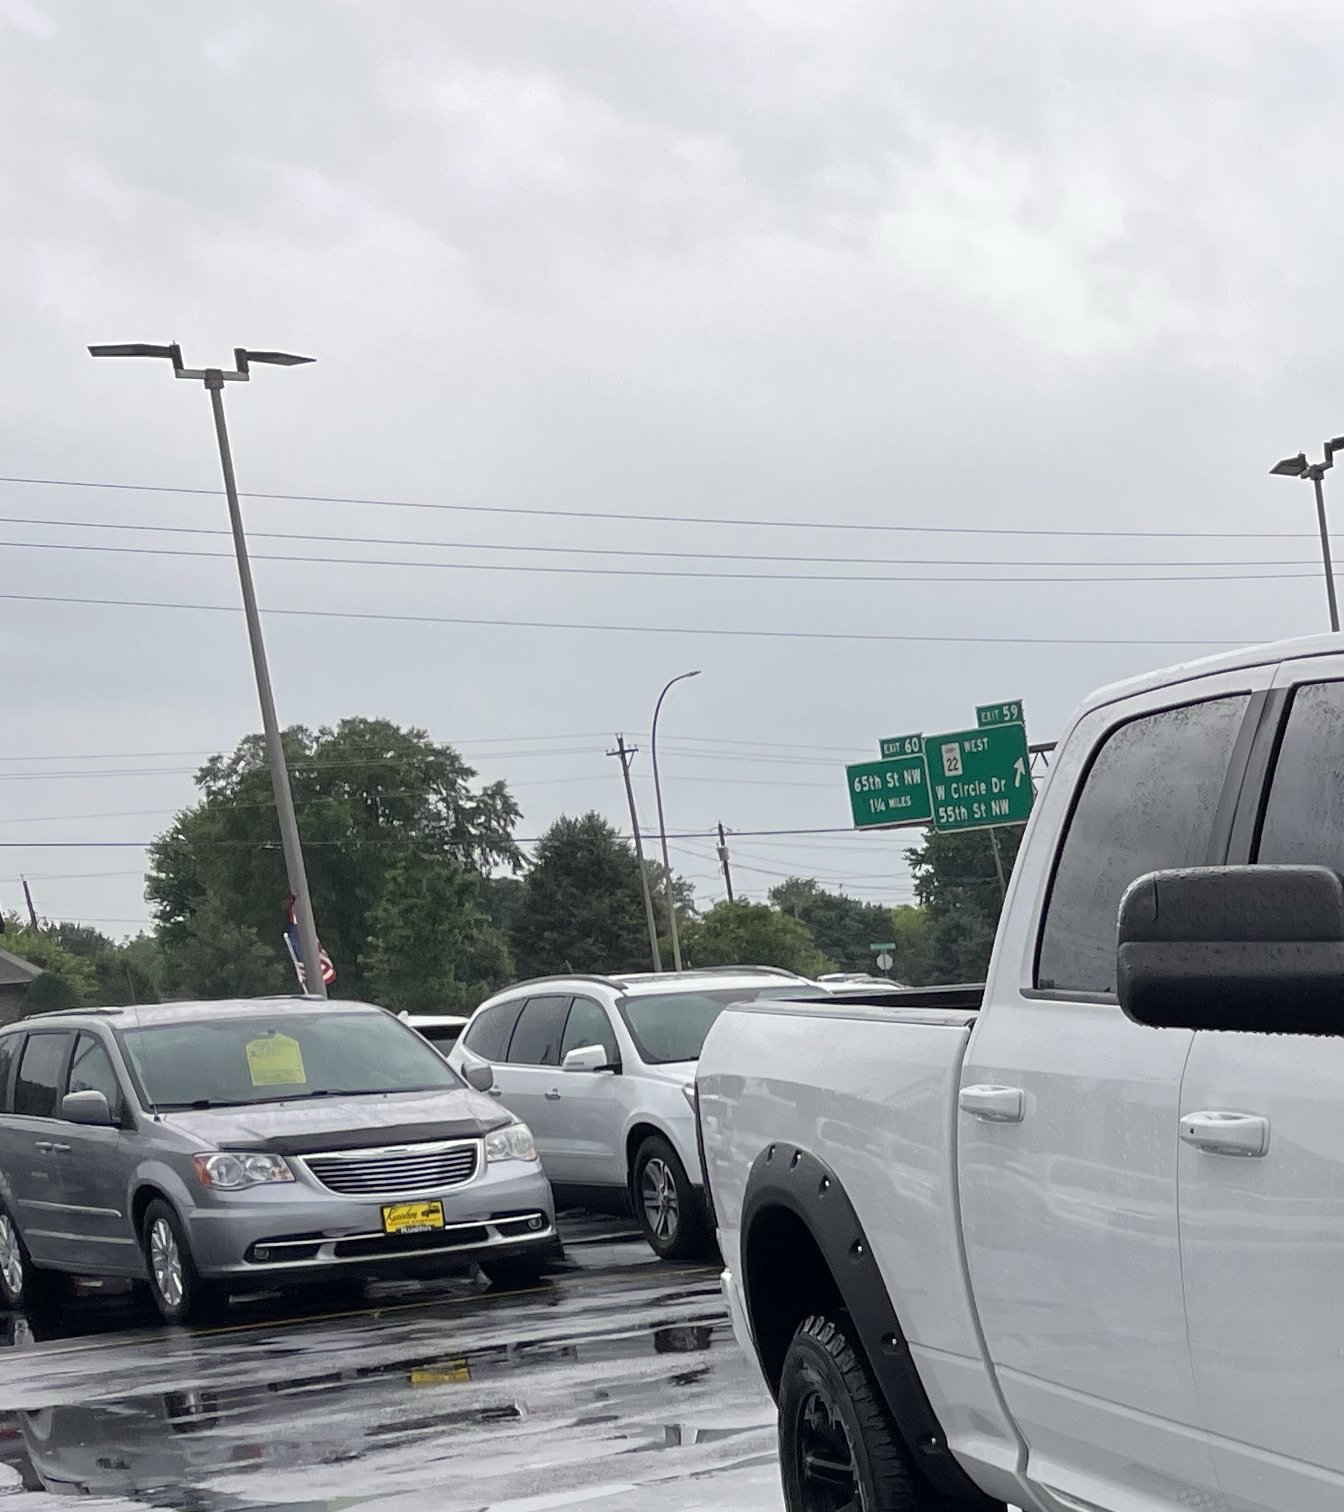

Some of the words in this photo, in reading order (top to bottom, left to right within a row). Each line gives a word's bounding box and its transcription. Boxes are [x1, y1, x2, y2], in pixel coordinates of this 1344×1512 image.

[981, 709, 999, 722] EXIT
[1003, 704, 1018, 720] 59
[884, 742, 900, 754] EXIT
[904, 737, 919, 753] 60
[963, 737, 988, 753] WEST
[946, 757, 959, 772] 22
[854, 774, 882, 793] 65th
[886, 771, 899, 788] St
[903, 768, 921, 785] NW
[936, 784, 945, 800] W
[951, 780, 986, 798] Circle
[991, 777, 1006, 793] Dr
[888, 795, 912, 808] MILES
[939, 805, 968, 823] 55th
[972, 802, 986, 818] St
[991, 799, 1009, 816] NW
